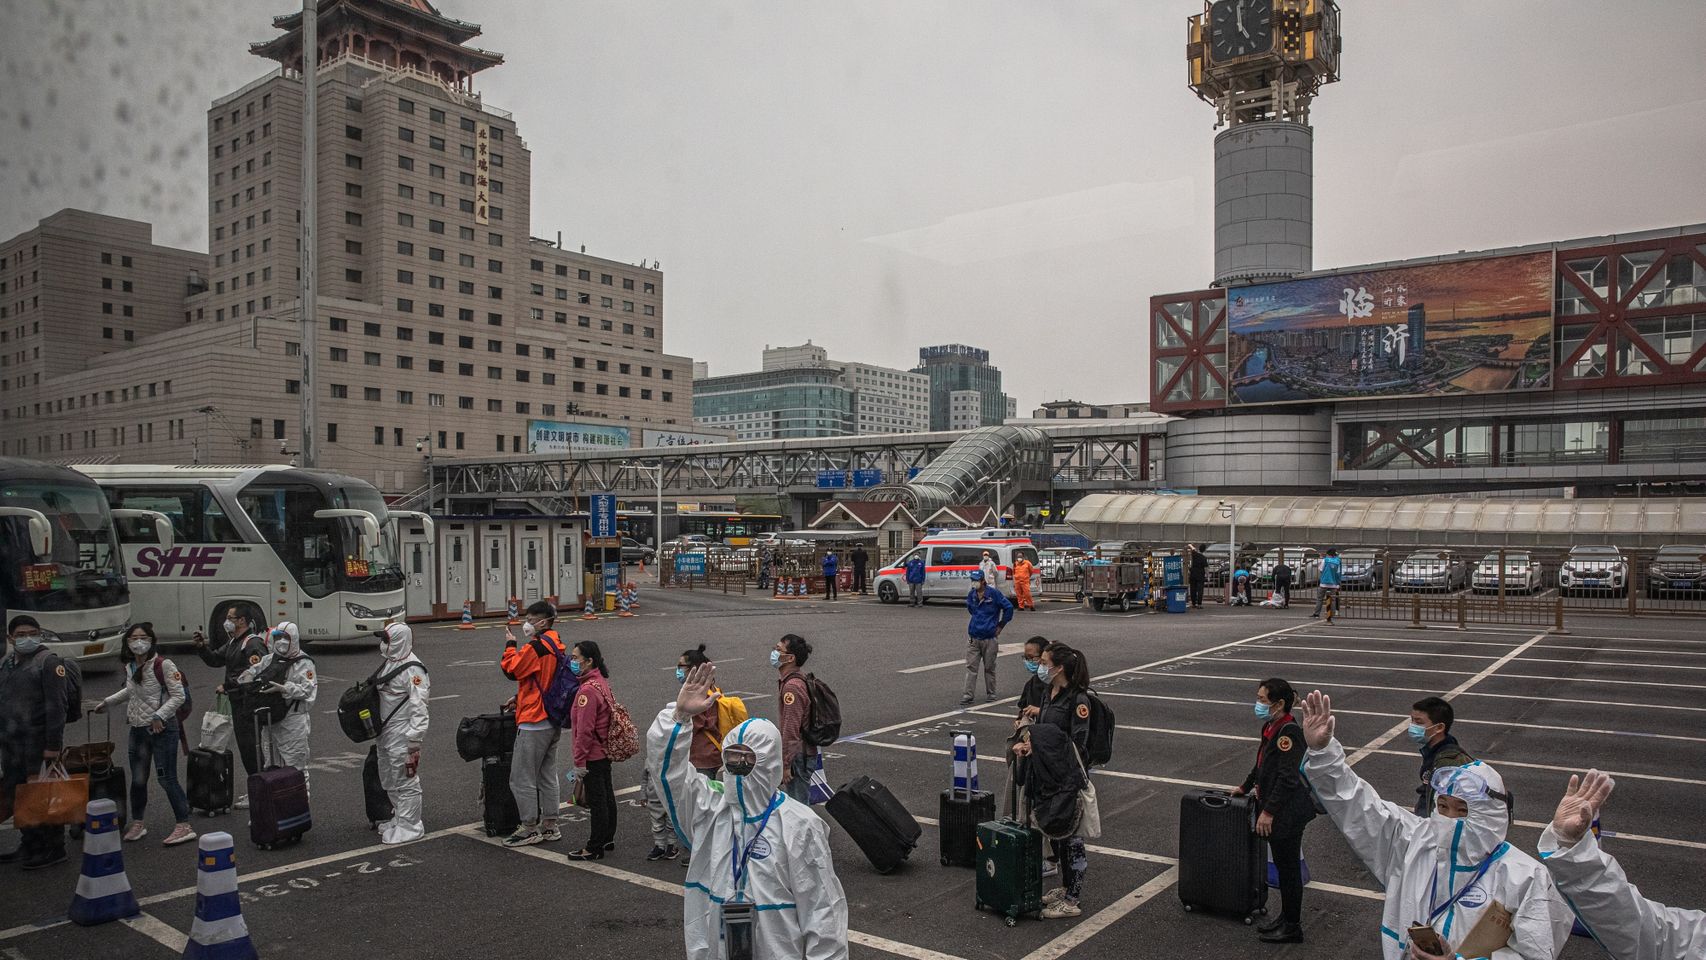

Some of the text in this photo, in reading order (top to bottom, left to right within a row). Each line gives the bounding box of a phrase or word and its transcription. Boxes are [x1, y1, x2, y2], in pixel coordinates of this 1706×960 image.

[477, 129, 488, 220] 北京瑞海大厦
[536, 429, 579, 443] 创建文明城市
[597, 495, 609, 537] 大型车专用出口
